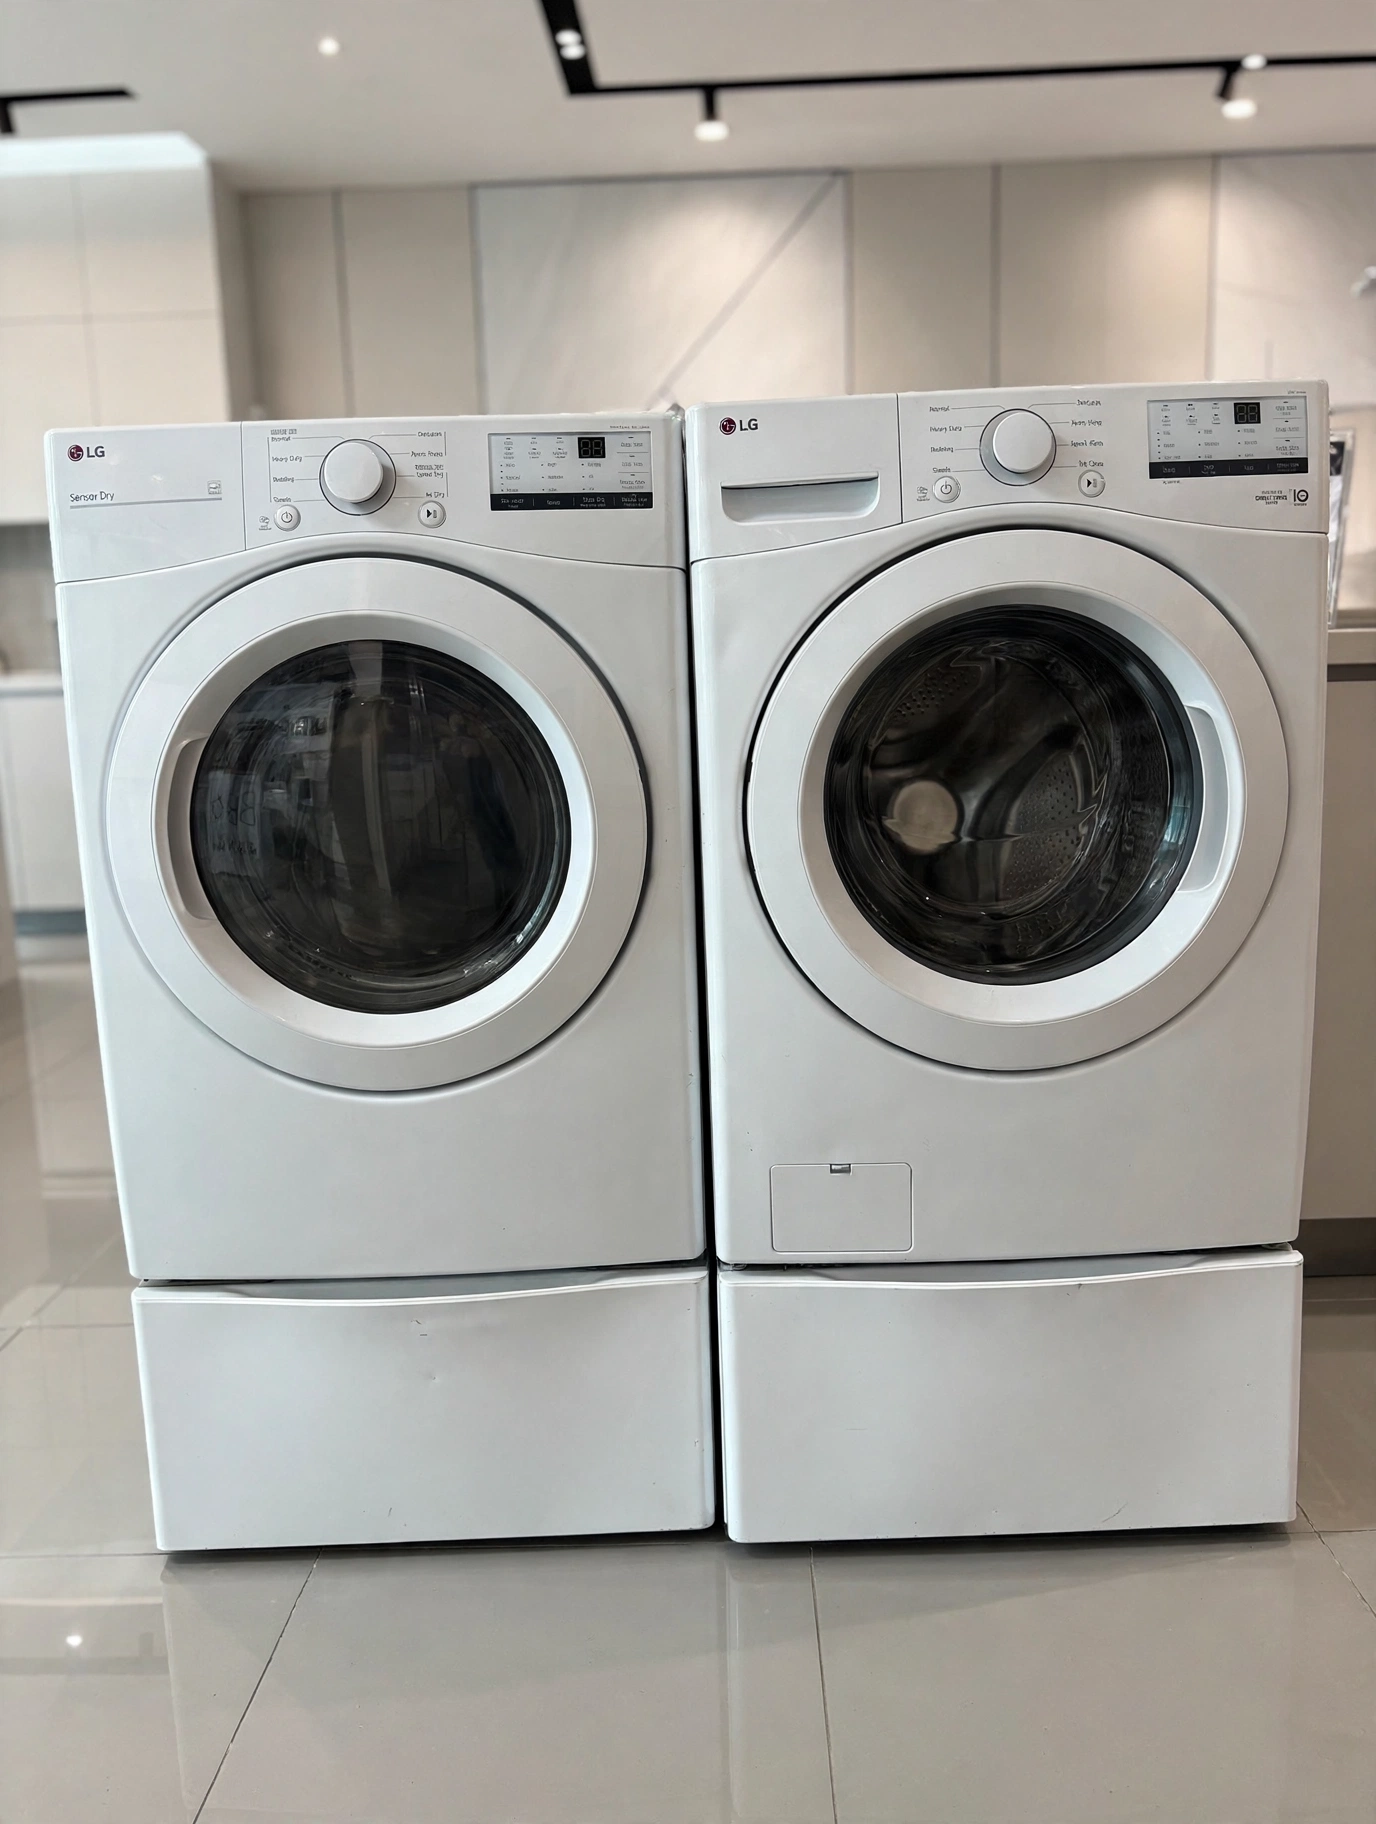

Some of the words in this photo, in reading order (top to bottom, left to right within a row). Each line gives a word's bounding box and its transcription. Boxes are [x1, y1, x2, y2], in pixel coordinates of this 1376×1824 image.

[739, 418, 759, 432] LG
[86, 445, 106, 459] LG
[69, 493, 98, 503] Sensor
[99, 490, 115, 502] Dry
